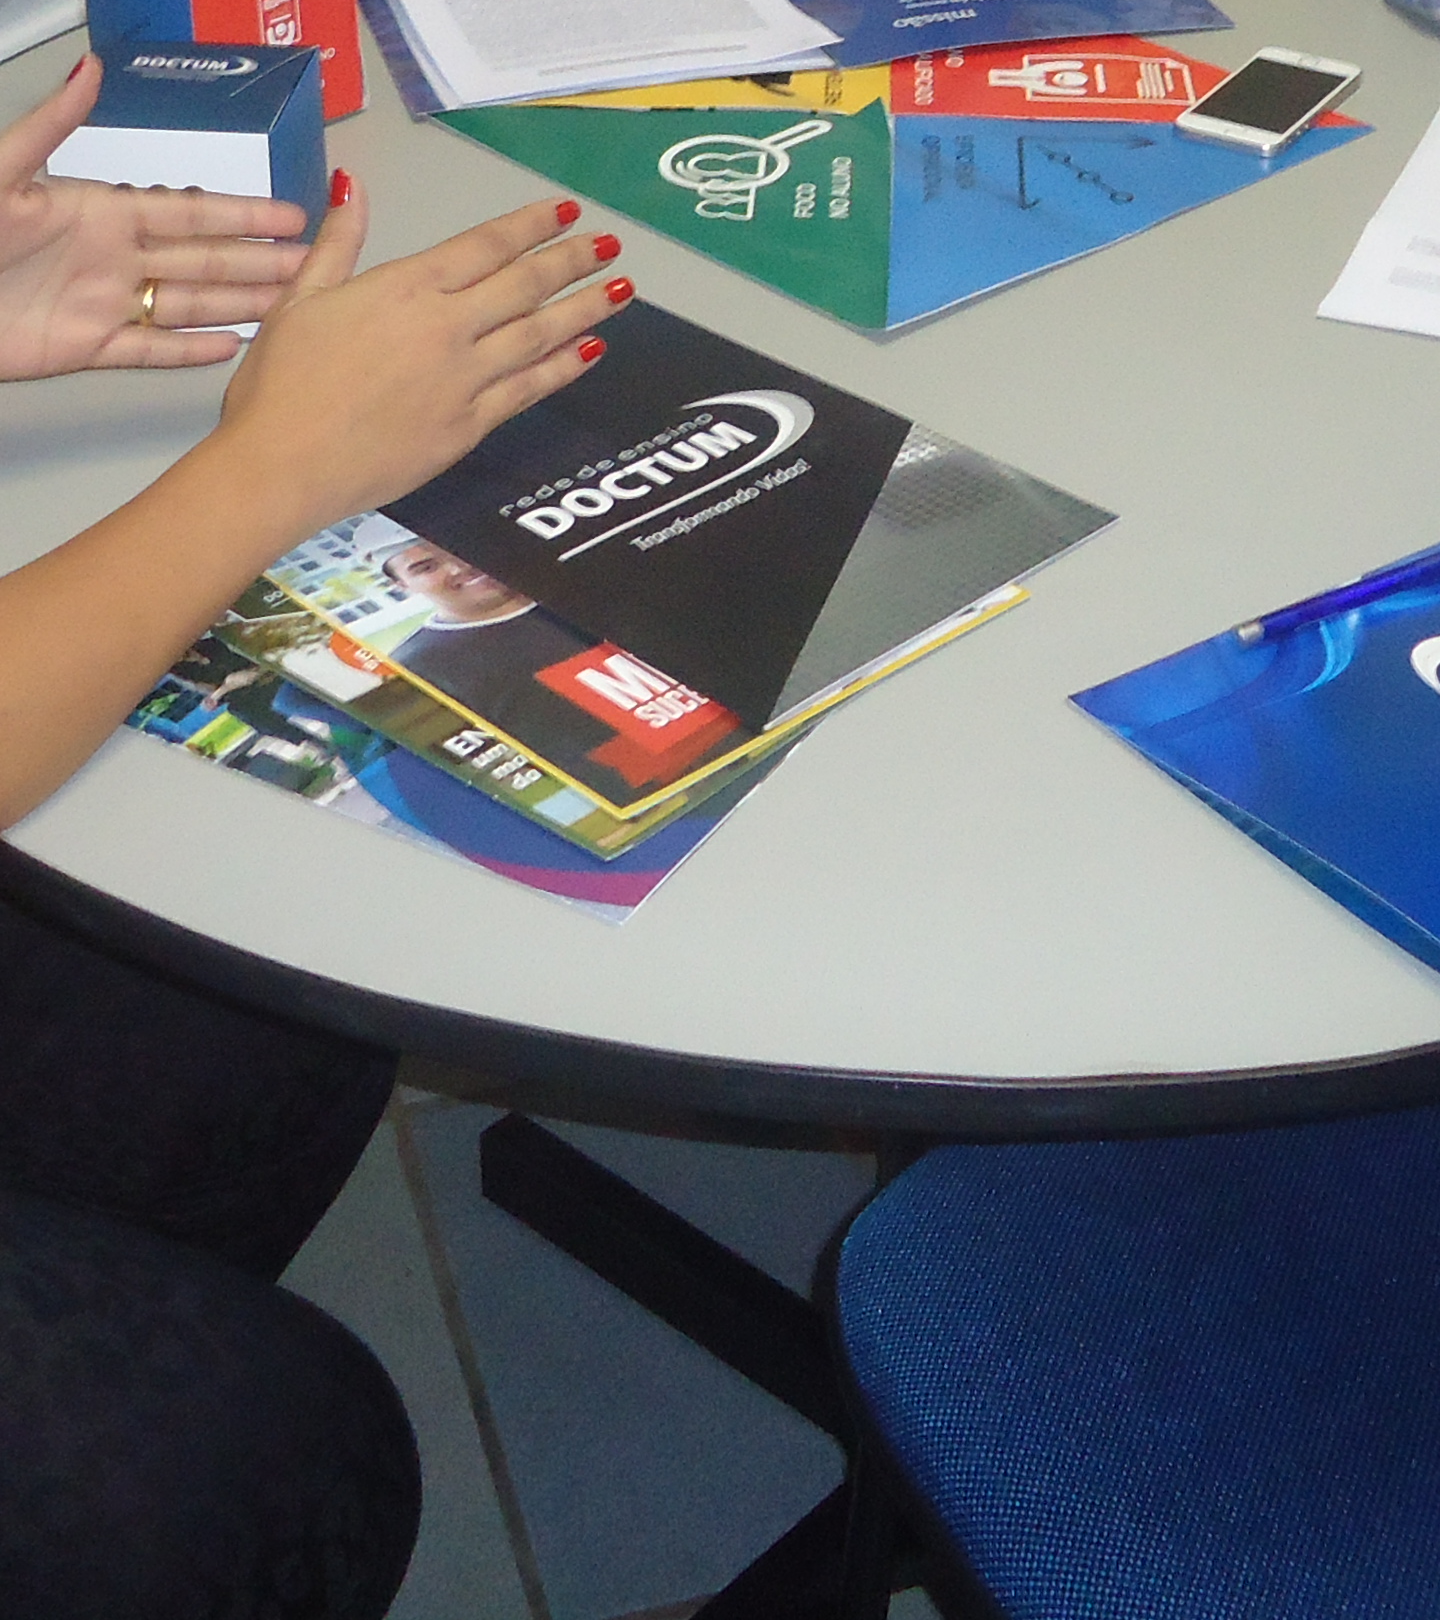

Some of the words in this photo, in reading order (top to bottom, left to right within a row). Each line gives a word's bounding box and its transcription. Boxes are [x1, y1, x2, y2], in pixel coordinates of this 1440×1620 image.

[132, 55, 229, 72] DOCTUM
[830, 156, 852, 197] ALUNO
[793, 182, 817, 219] FOCO
[828, 197, 850, 219] NO
[498, 476, 574, 518] rede
[576, 458, 615, 481] de
[617, 413, 714, 461] ensino
[515, 420, 758, 540] DOCTUM
